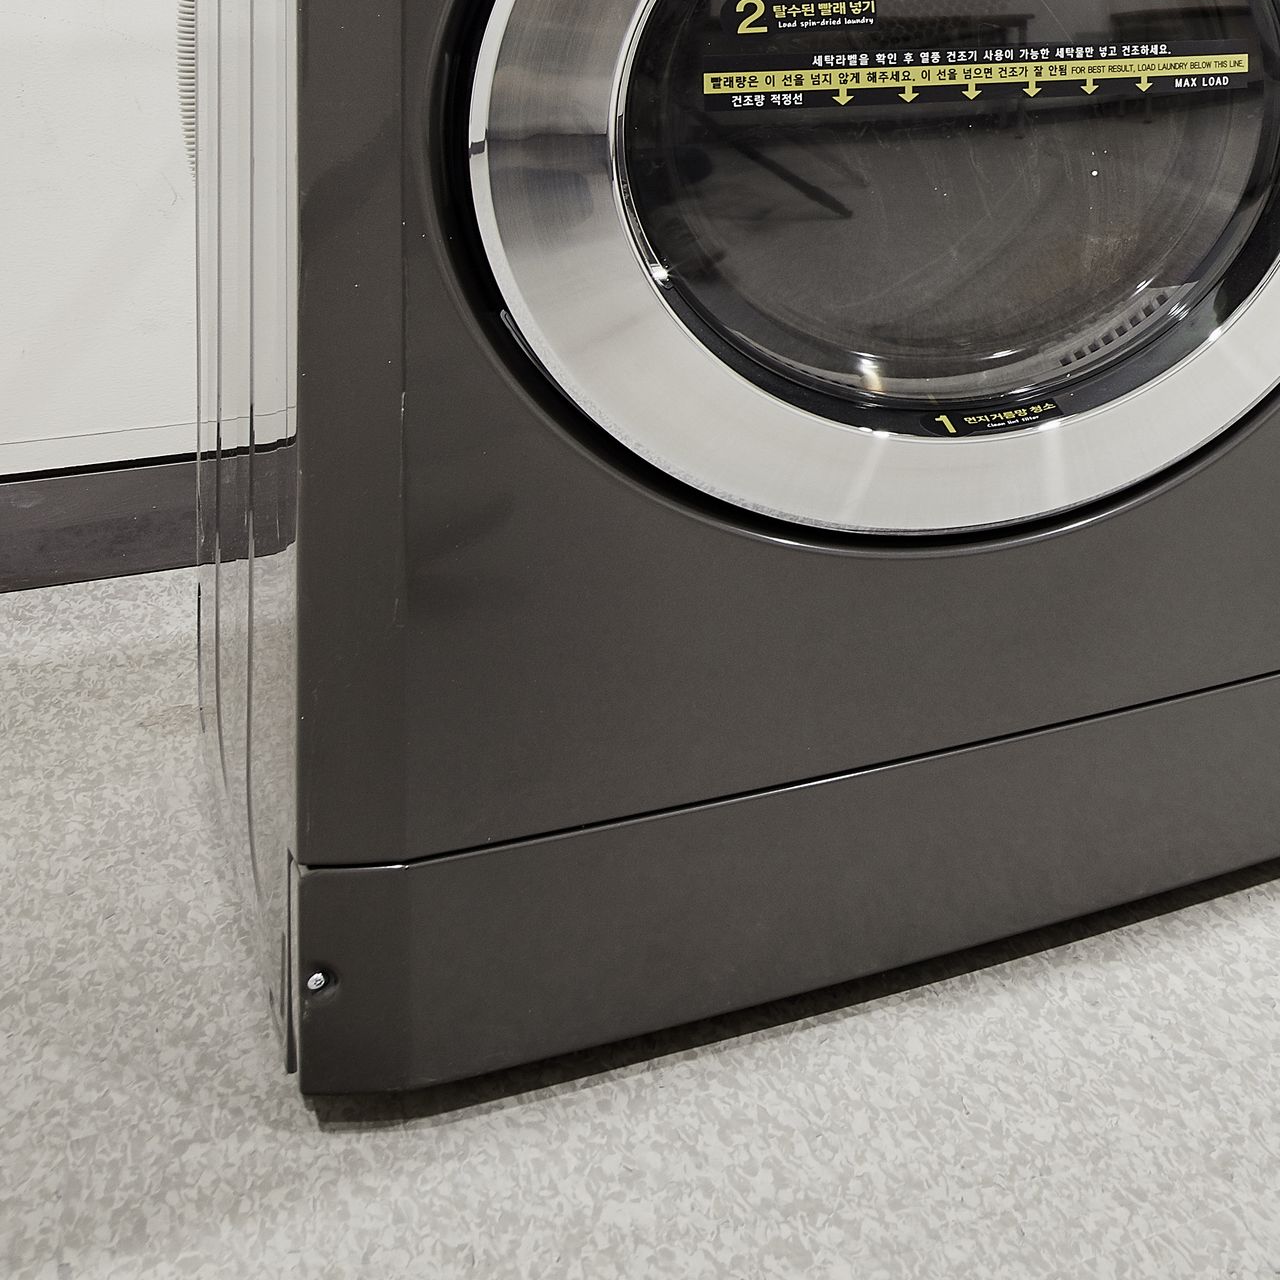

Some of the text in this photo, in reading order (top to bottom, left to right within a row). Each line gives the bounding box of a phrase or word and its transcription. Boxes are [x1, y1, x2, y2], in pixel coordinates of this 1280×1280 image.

[773, 0, 876, 18] 탈수된 빨래 넣기
[778, 16, 874, 29] Load spin-dried laundry
[812, 44, 1172, 67] 세탁라벨을 확인 후 열풍 건조기 사용이 가능한 세탁물만 넣고 건조하세요.
[711, 60, 1228, 89] 빨래량은 이 선을 넘지 않게 해주세요. 이 선을 넘으면 건조가 잘 안됨 FOR BEST RESULT, LOAD LAUNDRY BELOW THIS
[731, 76, 1229, 107] 건조량 적정선 MAX LOAD
[934, 415, 957, 434] 1
